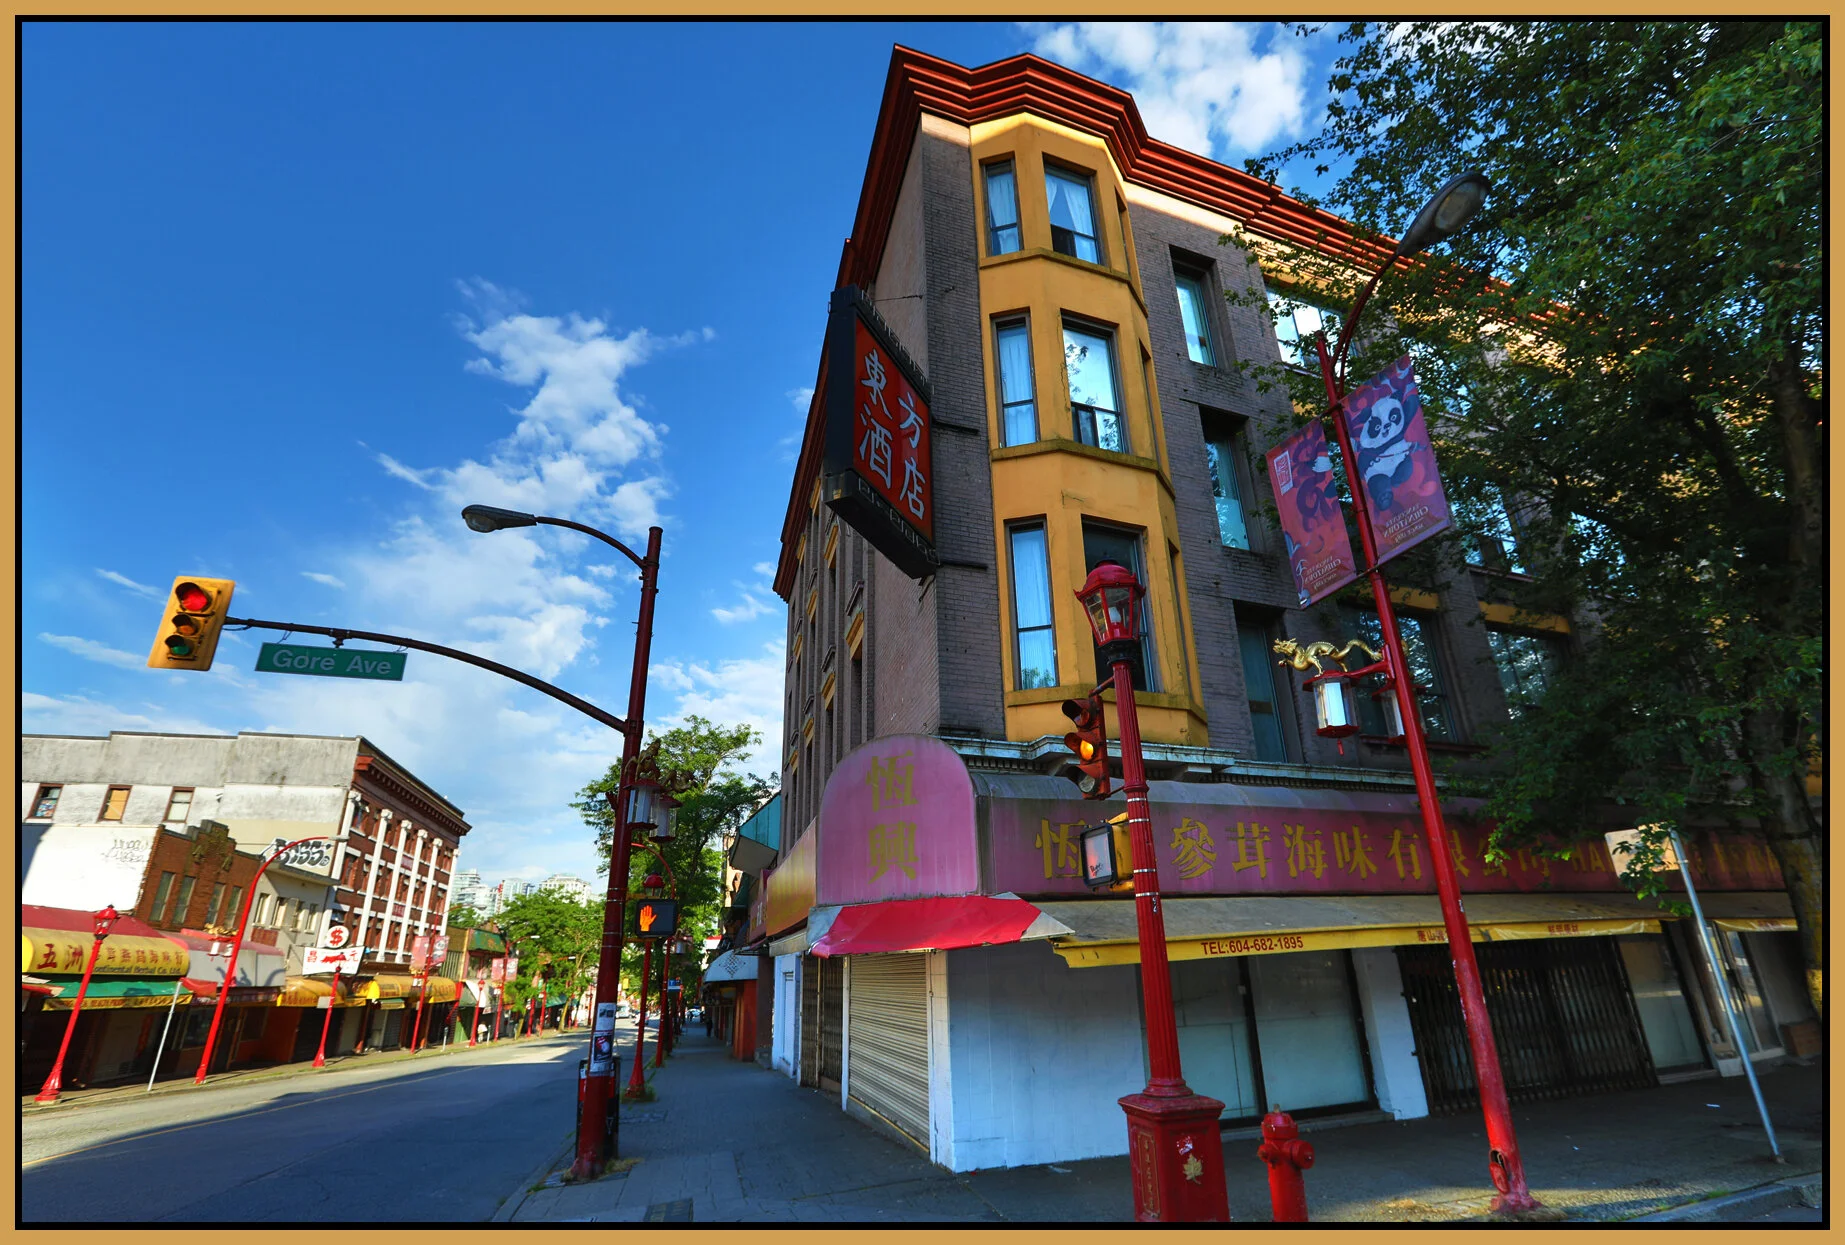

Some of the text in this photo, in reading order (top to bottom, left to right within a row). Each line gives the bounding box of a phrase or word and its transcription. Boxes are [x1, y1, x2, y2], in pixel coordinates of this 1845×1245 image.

[861, 349, 924, 449] 東方
[859, 403, 926, 520] 酒店
[272, 649, 391, 674] Gore Ave
[1201, 936, 1304, 955] TEL:604-682-1895
[95, 964, 132, 973] ontinental
